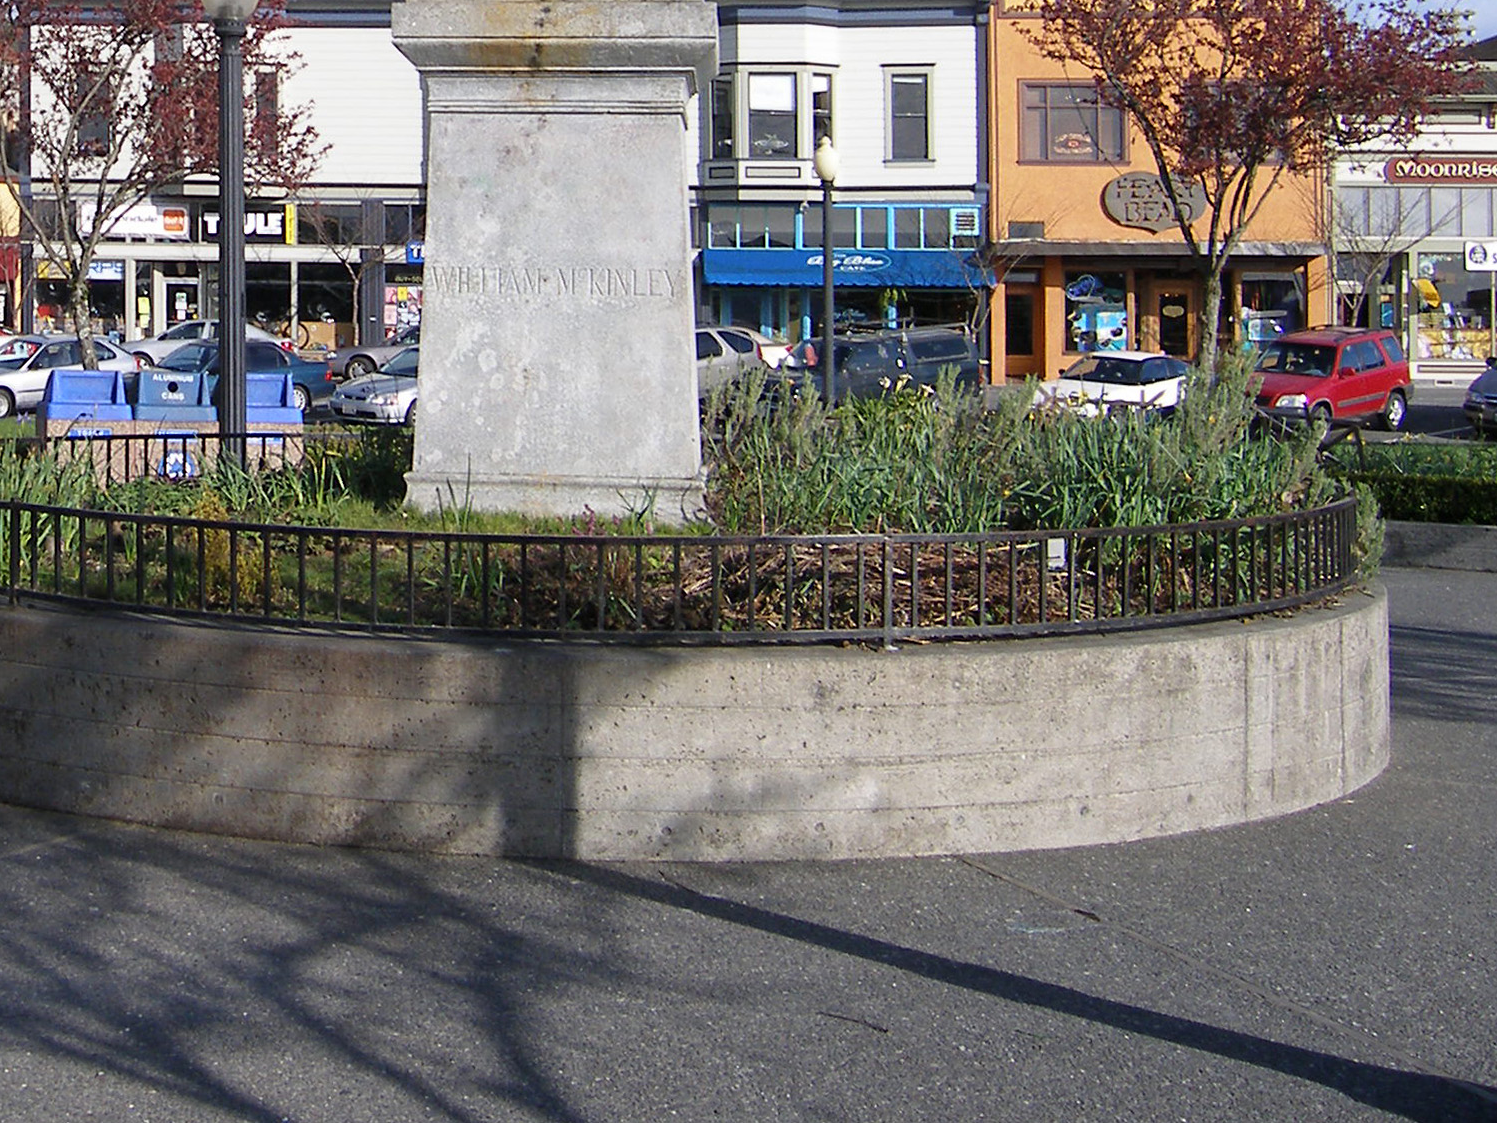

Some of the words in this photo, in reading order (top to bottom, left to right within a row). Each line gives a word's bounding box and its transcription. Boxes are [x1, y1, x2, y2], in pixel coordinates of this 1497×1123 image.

[204, 212, 285, 235] TULE
[152, 373, 194, 383] ALUMINUM
[161, 392, 185, 401] CANS
